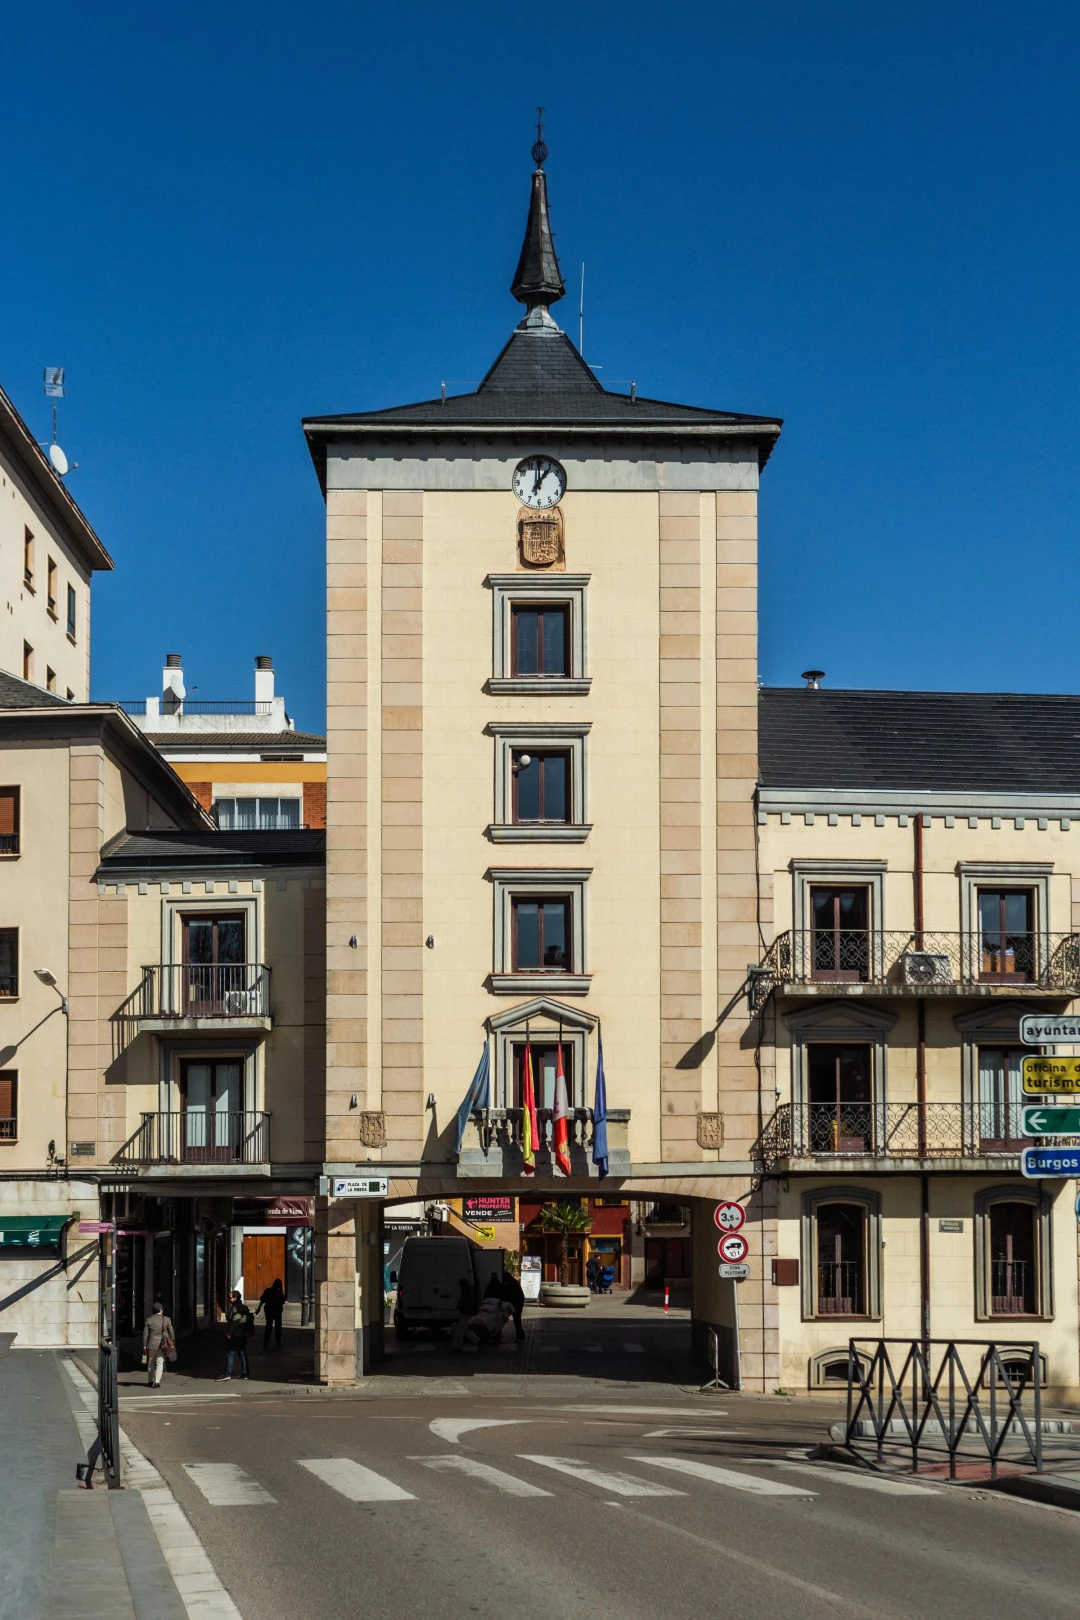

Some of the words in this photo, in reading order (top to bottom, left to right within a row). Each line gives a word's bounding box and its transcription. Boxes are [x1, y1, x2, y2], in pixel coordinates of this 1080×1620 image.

[1026, 1024, 1080, 1038] ayunta
[1026, 1063, 1066, 1072] oficina
[1028, 1157, 1078, 1170] Burgos
[721, 1213, 734, 1222] 3,5
